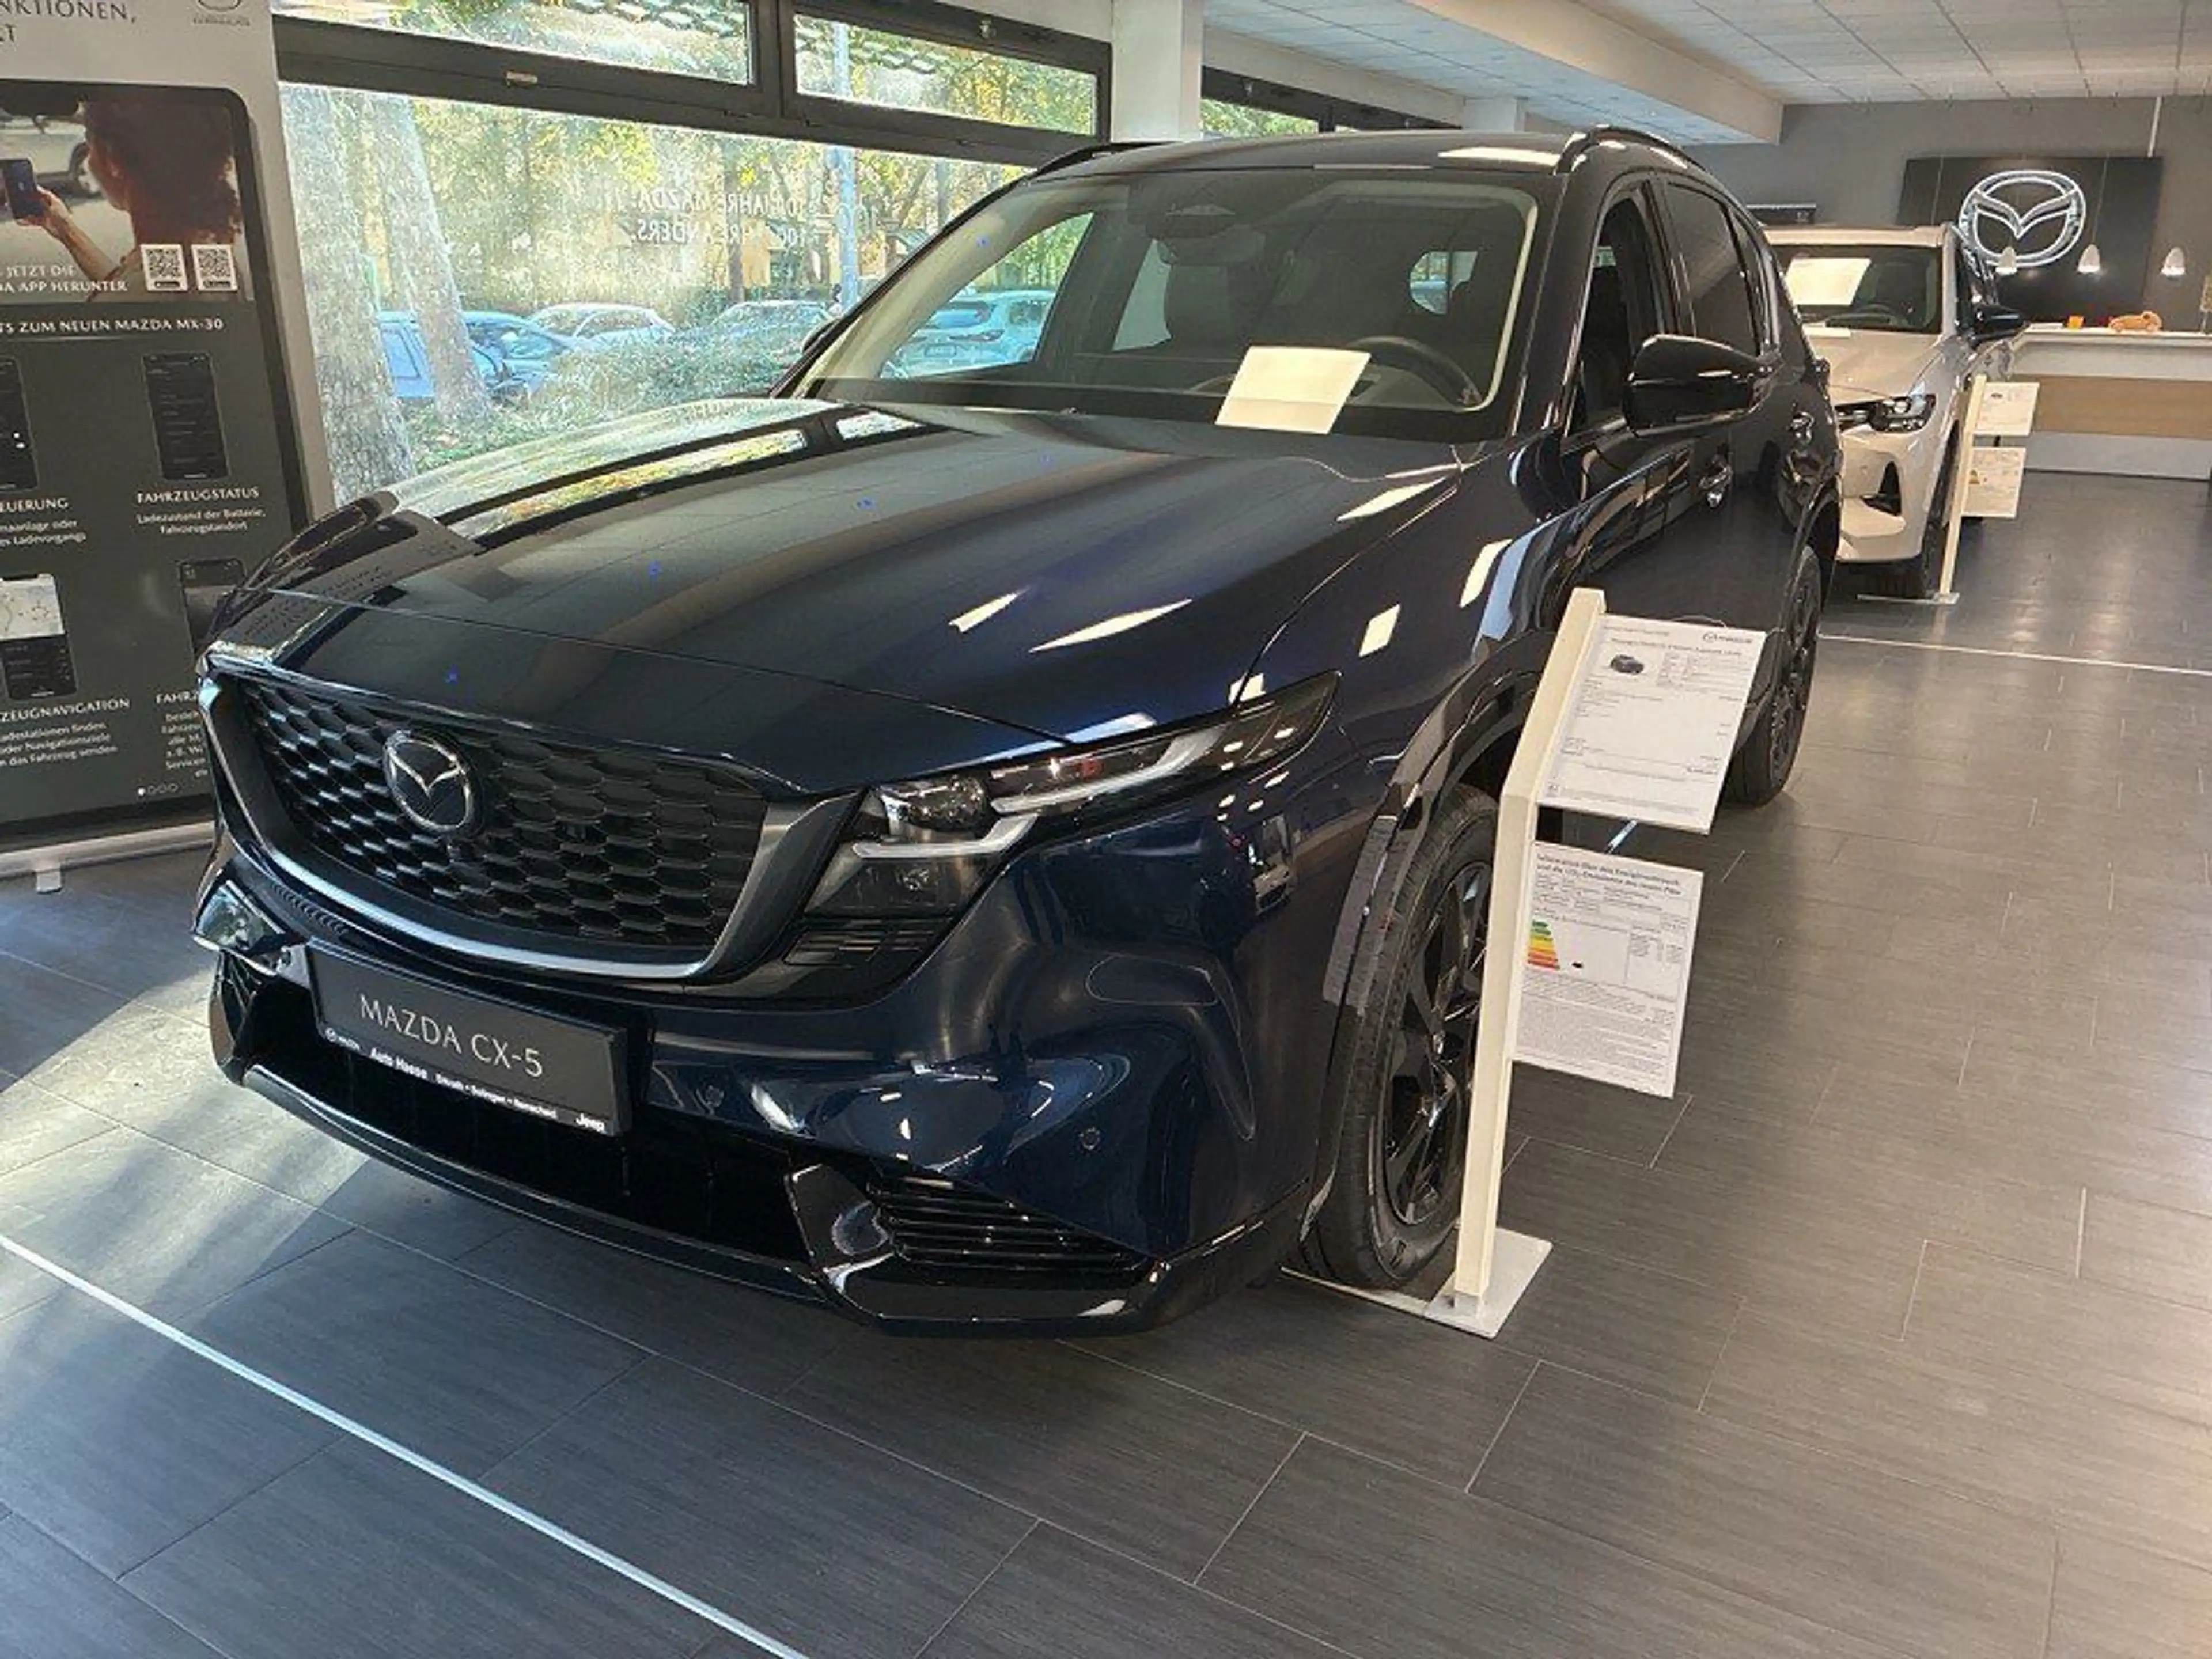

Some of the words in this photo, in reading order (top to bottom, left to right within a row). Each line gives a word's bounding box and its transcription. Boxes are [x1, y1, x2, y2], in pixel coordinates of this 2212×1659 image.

[19, 321, 56, 334] ZUM
[59, 320, 111, 333] NEUEN
[115, 319, 172, 331] MAZDA
[176, 318, 224, 331] MX-30
[137, 487, 259, 503] FAHRZEUGSTATUS
[359, 993, 462, 1054] MAZDA
[471, 1033, 543, 1078] CX-5
